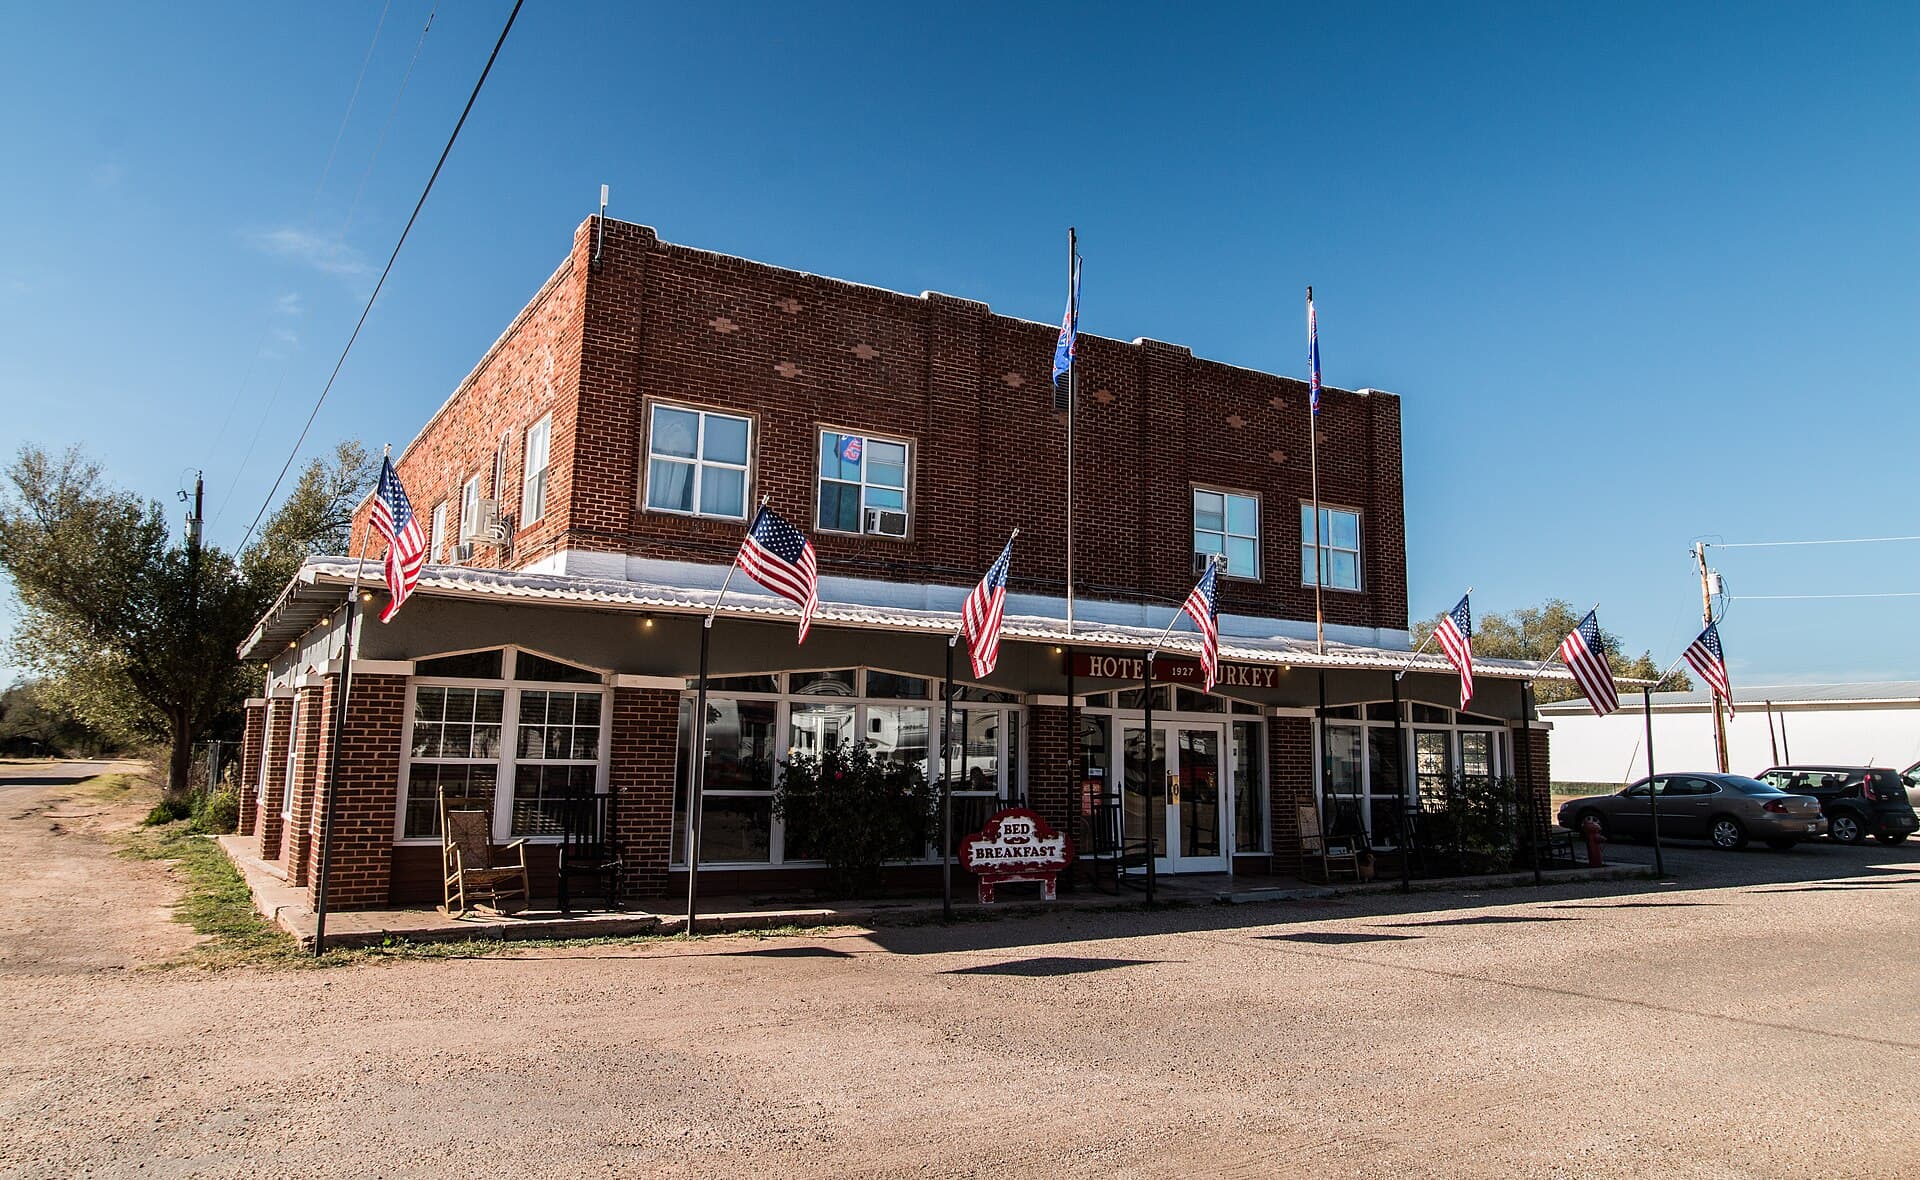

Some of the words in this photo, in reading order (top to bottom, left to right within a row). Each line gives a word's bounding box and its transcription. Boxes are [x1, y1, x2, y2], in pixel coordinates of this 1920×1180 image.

[1089, 655, 1157, 680] HOTEL
[1172, 666, 1194, 676] 1927
[1003, 823, 1030, 835] BED
[975, 846, 1056, 859] BREAKFAST
